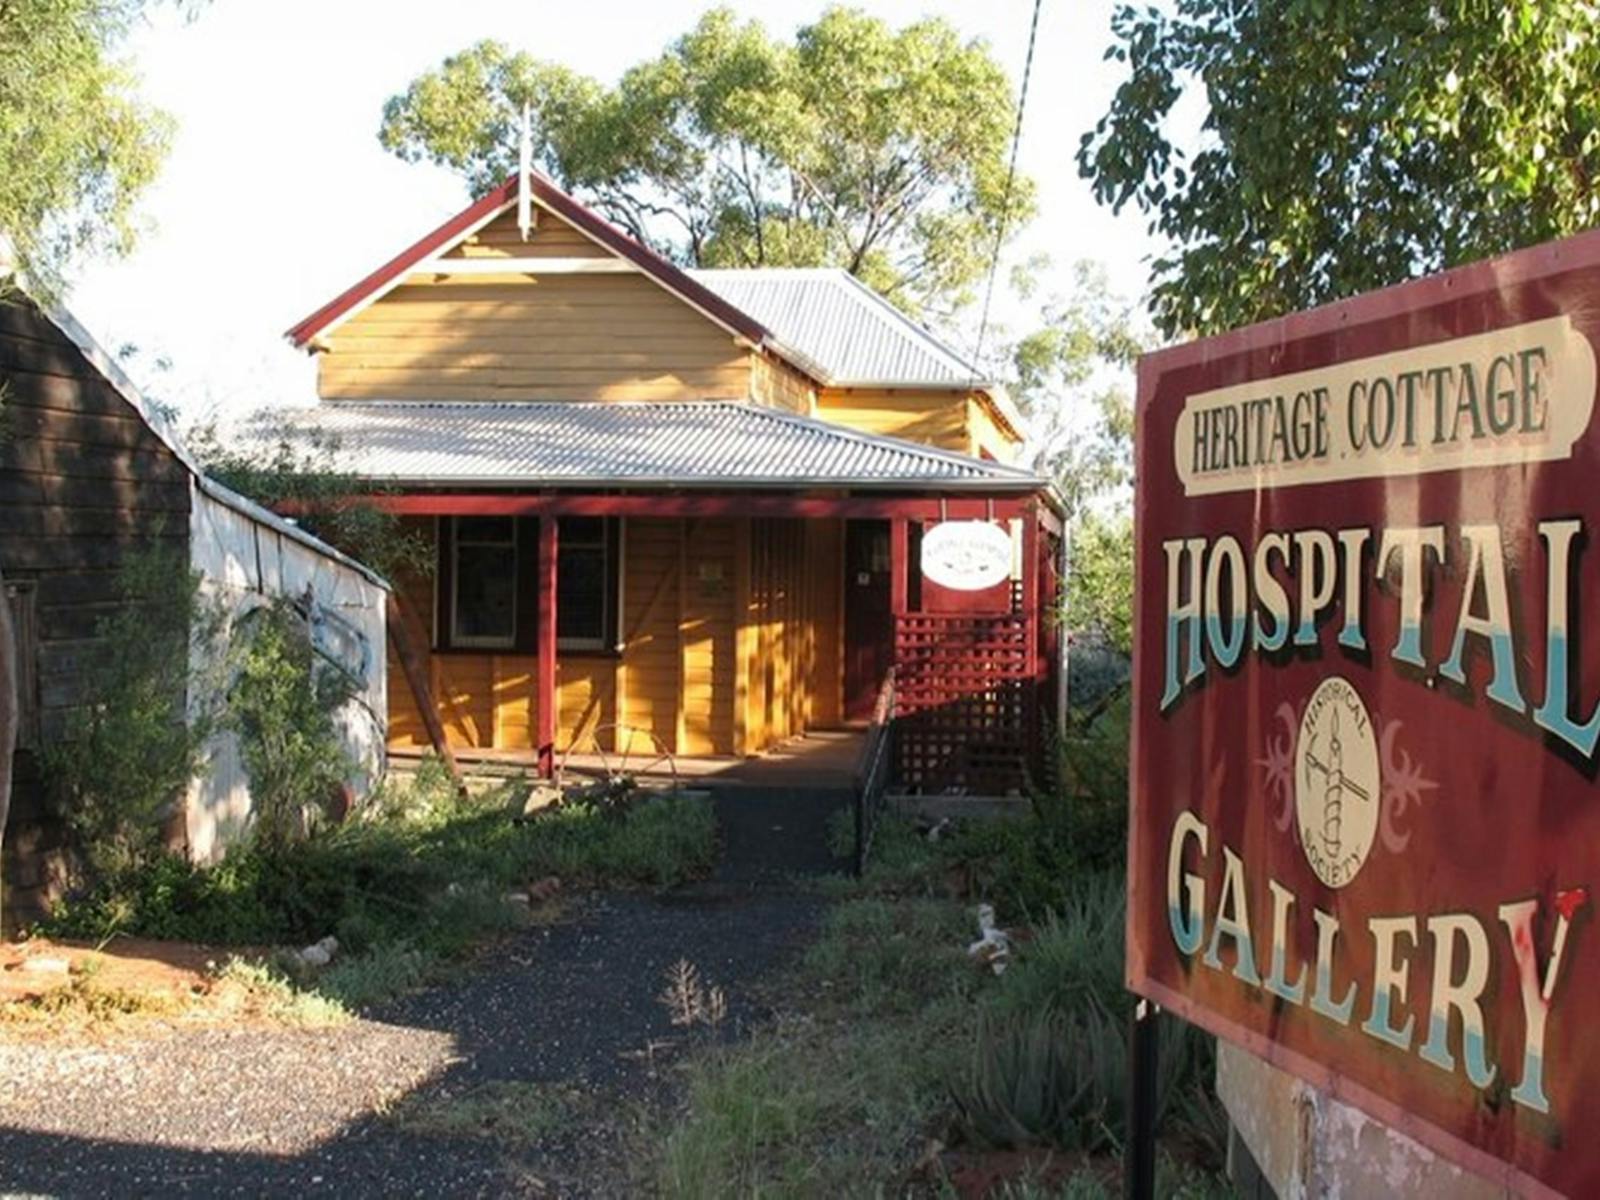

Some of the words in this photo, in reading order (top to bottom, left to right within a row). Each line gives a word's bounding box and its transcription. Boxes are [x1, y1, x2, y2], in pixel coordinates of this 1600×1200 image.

[1191, 387, 1329, 474] HERITAGE
[1347, 346, 1548, 450] COTTAGE
[1160, 519, 1600, 758] HOSPITAL
[1166, 809, 1588, 1114] GALLERY
